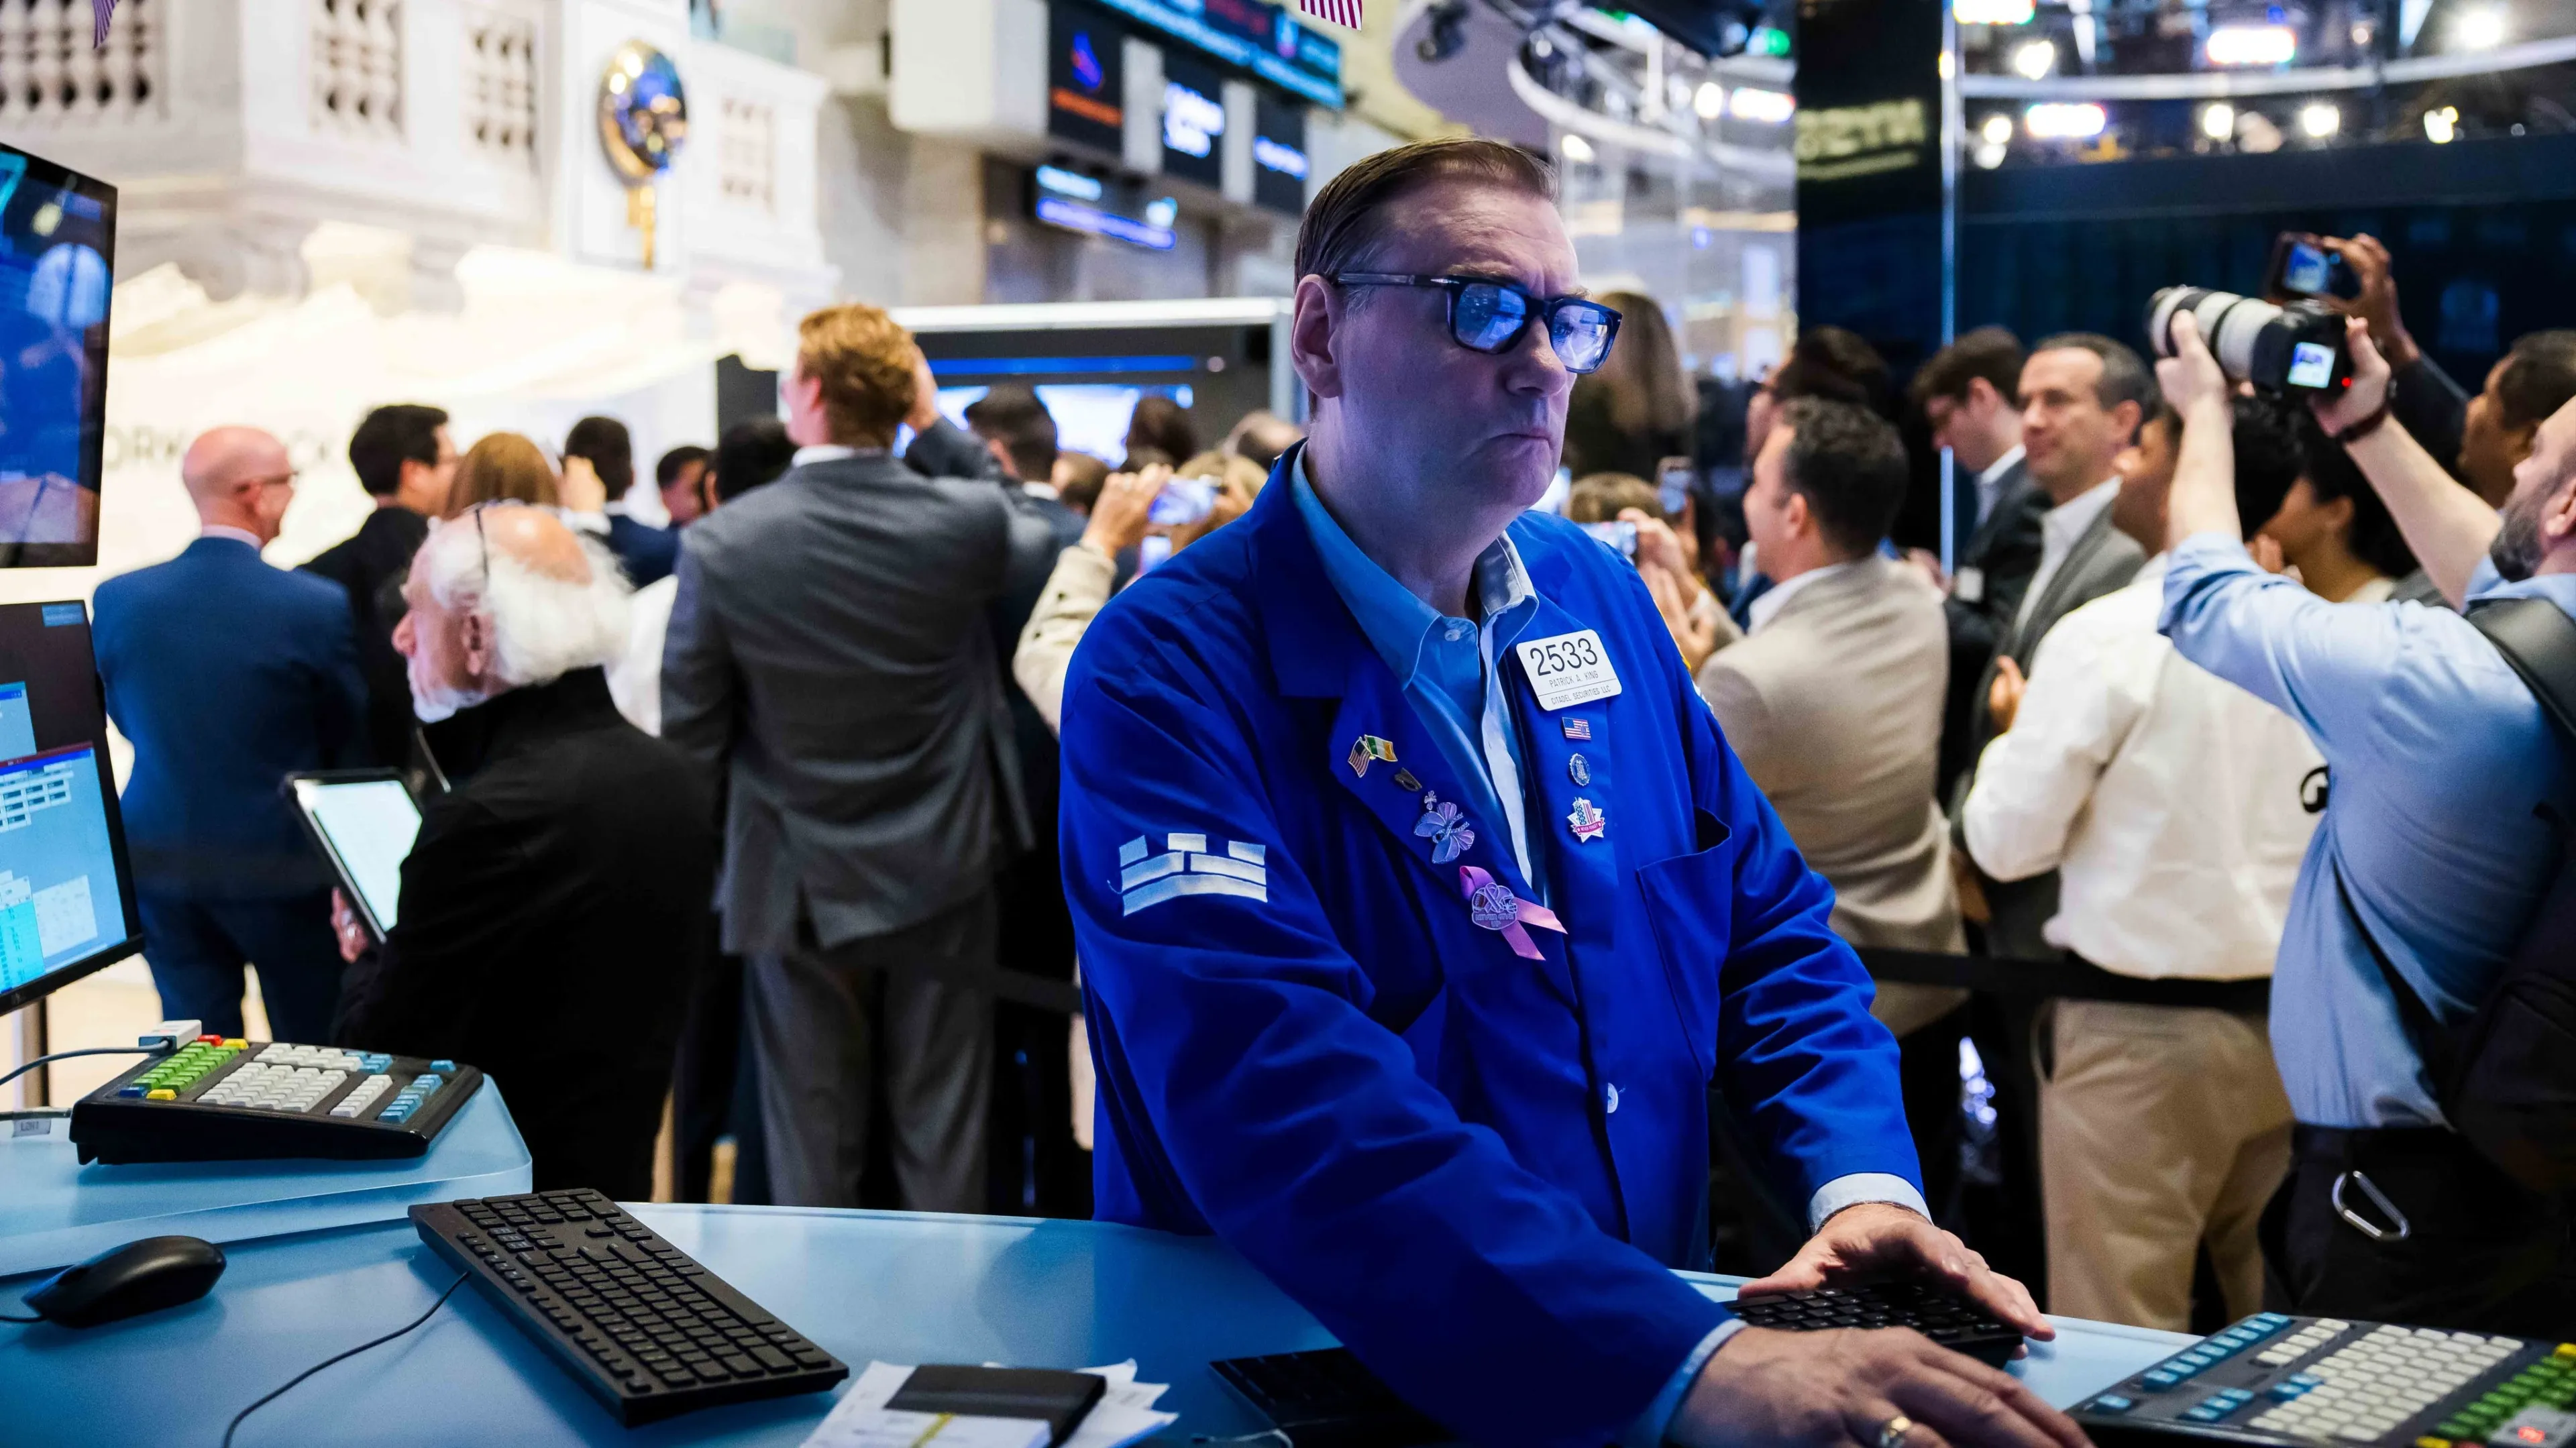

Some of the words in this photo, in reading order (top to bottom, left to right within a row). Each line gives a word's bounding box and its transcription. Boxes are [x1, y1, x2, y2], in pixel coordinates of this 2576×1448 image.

[1530, 638, 1597, 676] 2533
[1549, 675, 1574, 688] PATRICK
[1585, 671, 1599, 681] KING
[1551, 695, 1572, 705] CITADEL
[1573, 688, 1600, 700] SECURITIES
[1602, 685, 1611, 693] LLC
